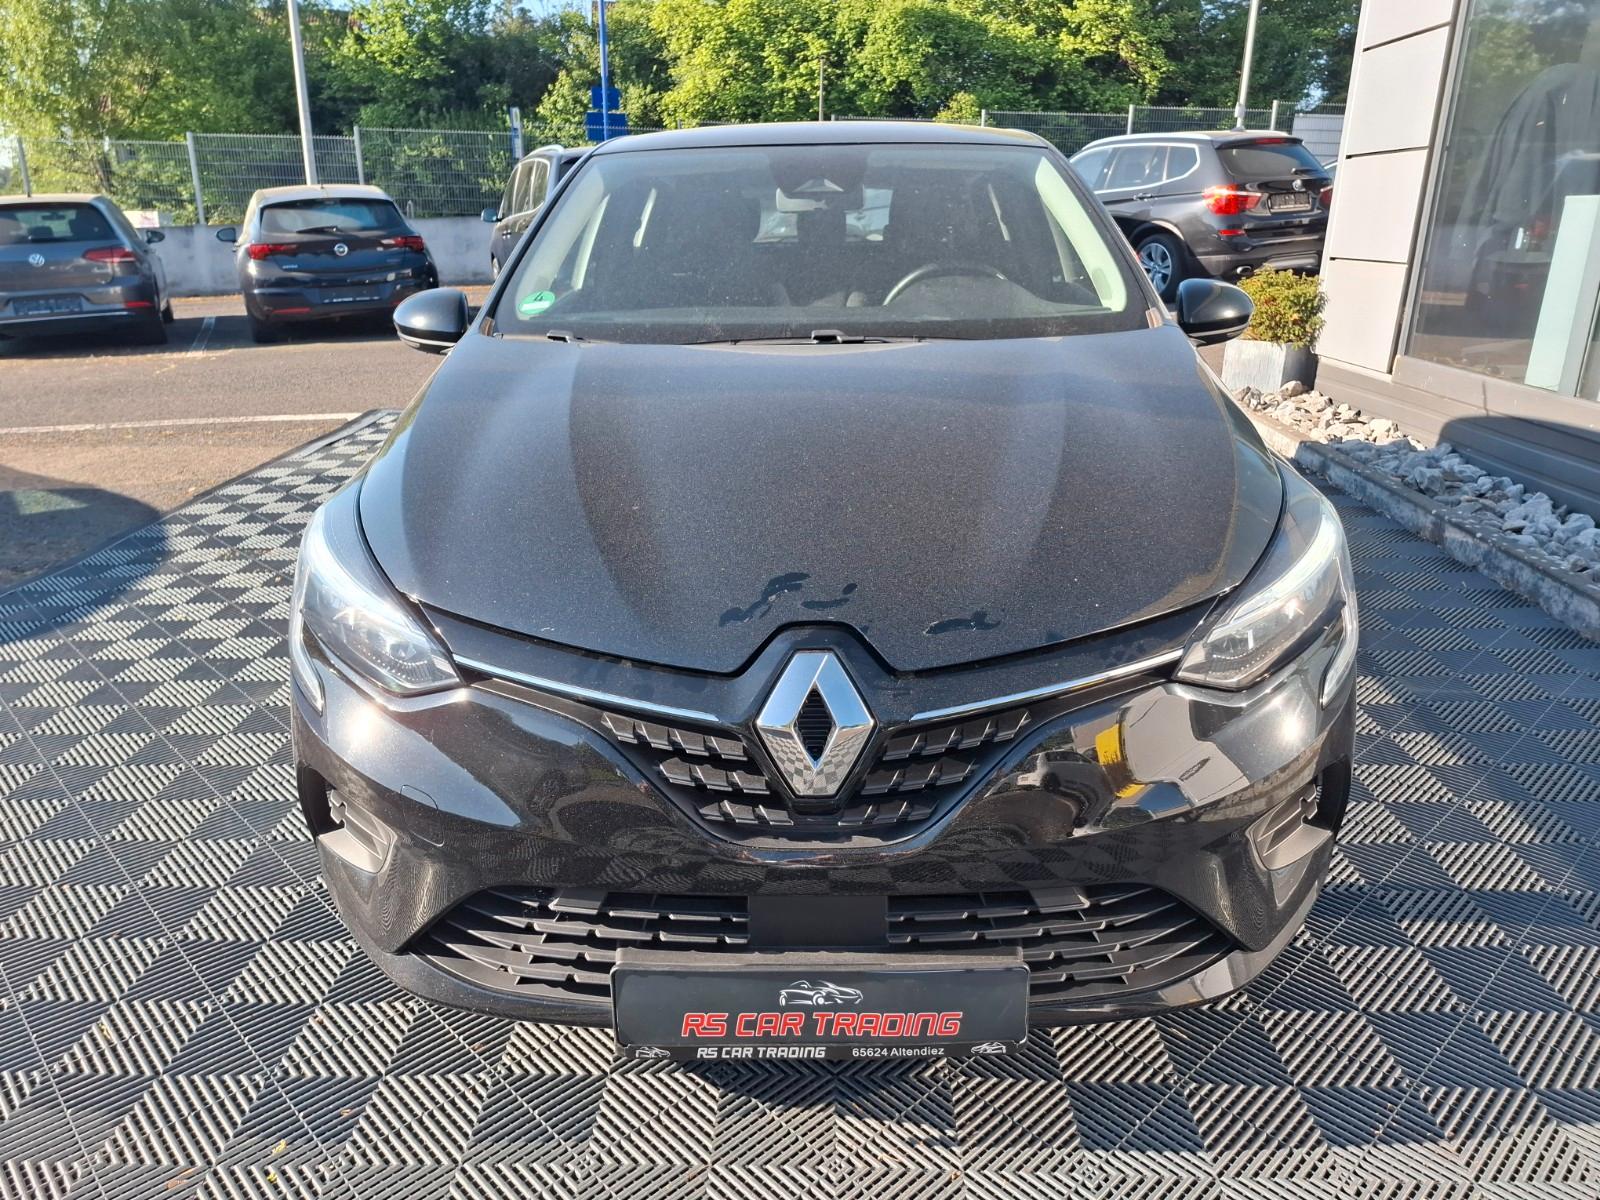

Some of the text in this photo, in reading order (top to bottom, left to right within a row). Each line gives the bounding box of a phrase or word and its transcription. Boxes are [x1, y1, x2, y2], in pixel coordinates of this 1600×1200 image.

[681, 1011, 963, 1037] RS CAR TRADING
[696, 1046, 827, 1059] RS CAR TRADING
[852, 1046, 945, 1058] 65624 Altendiez
